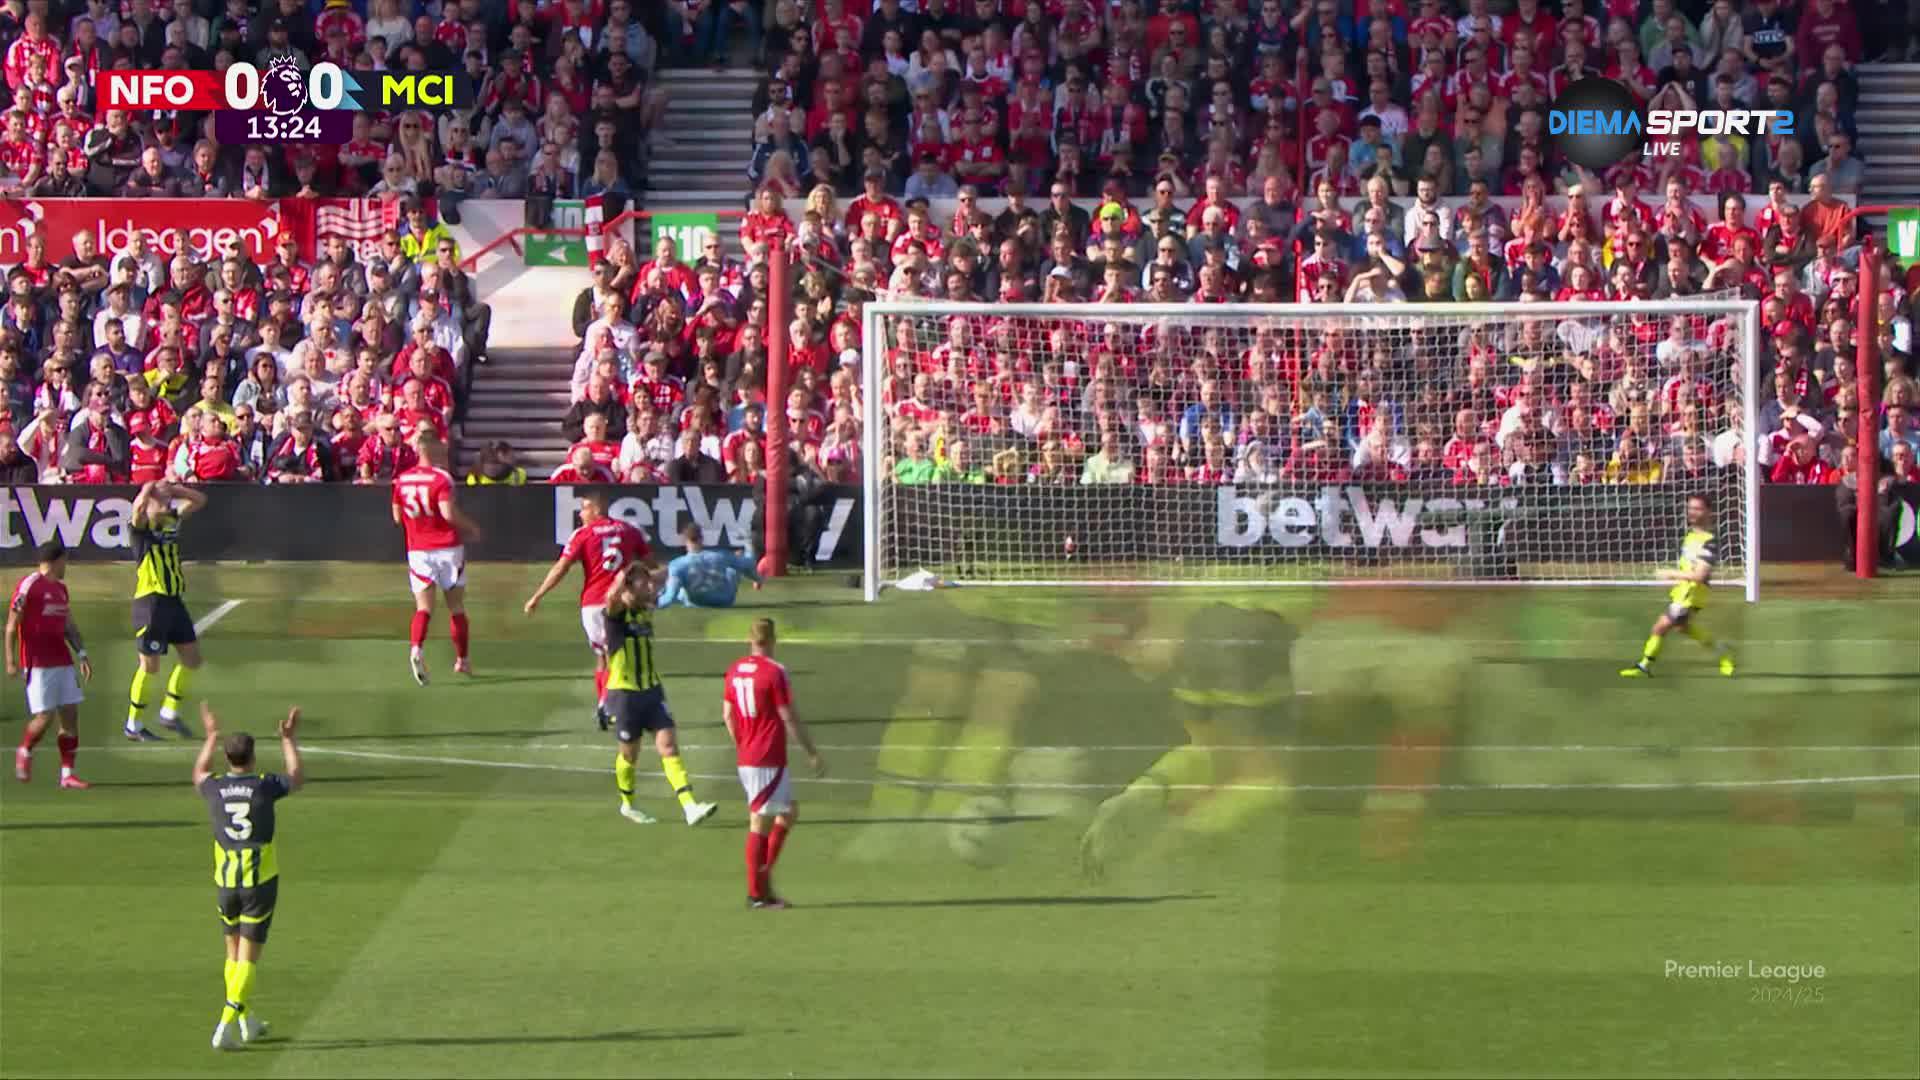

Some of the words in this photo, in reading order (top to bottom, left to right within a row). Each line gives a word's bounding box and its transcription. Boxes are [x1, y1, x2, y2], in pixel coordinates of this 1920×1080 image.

[400, 485, 433, 518] 31
[602, 536, 623, 571] 5
[733, 677, 757, 718] 11
[223, 802, 253, 841] 3
